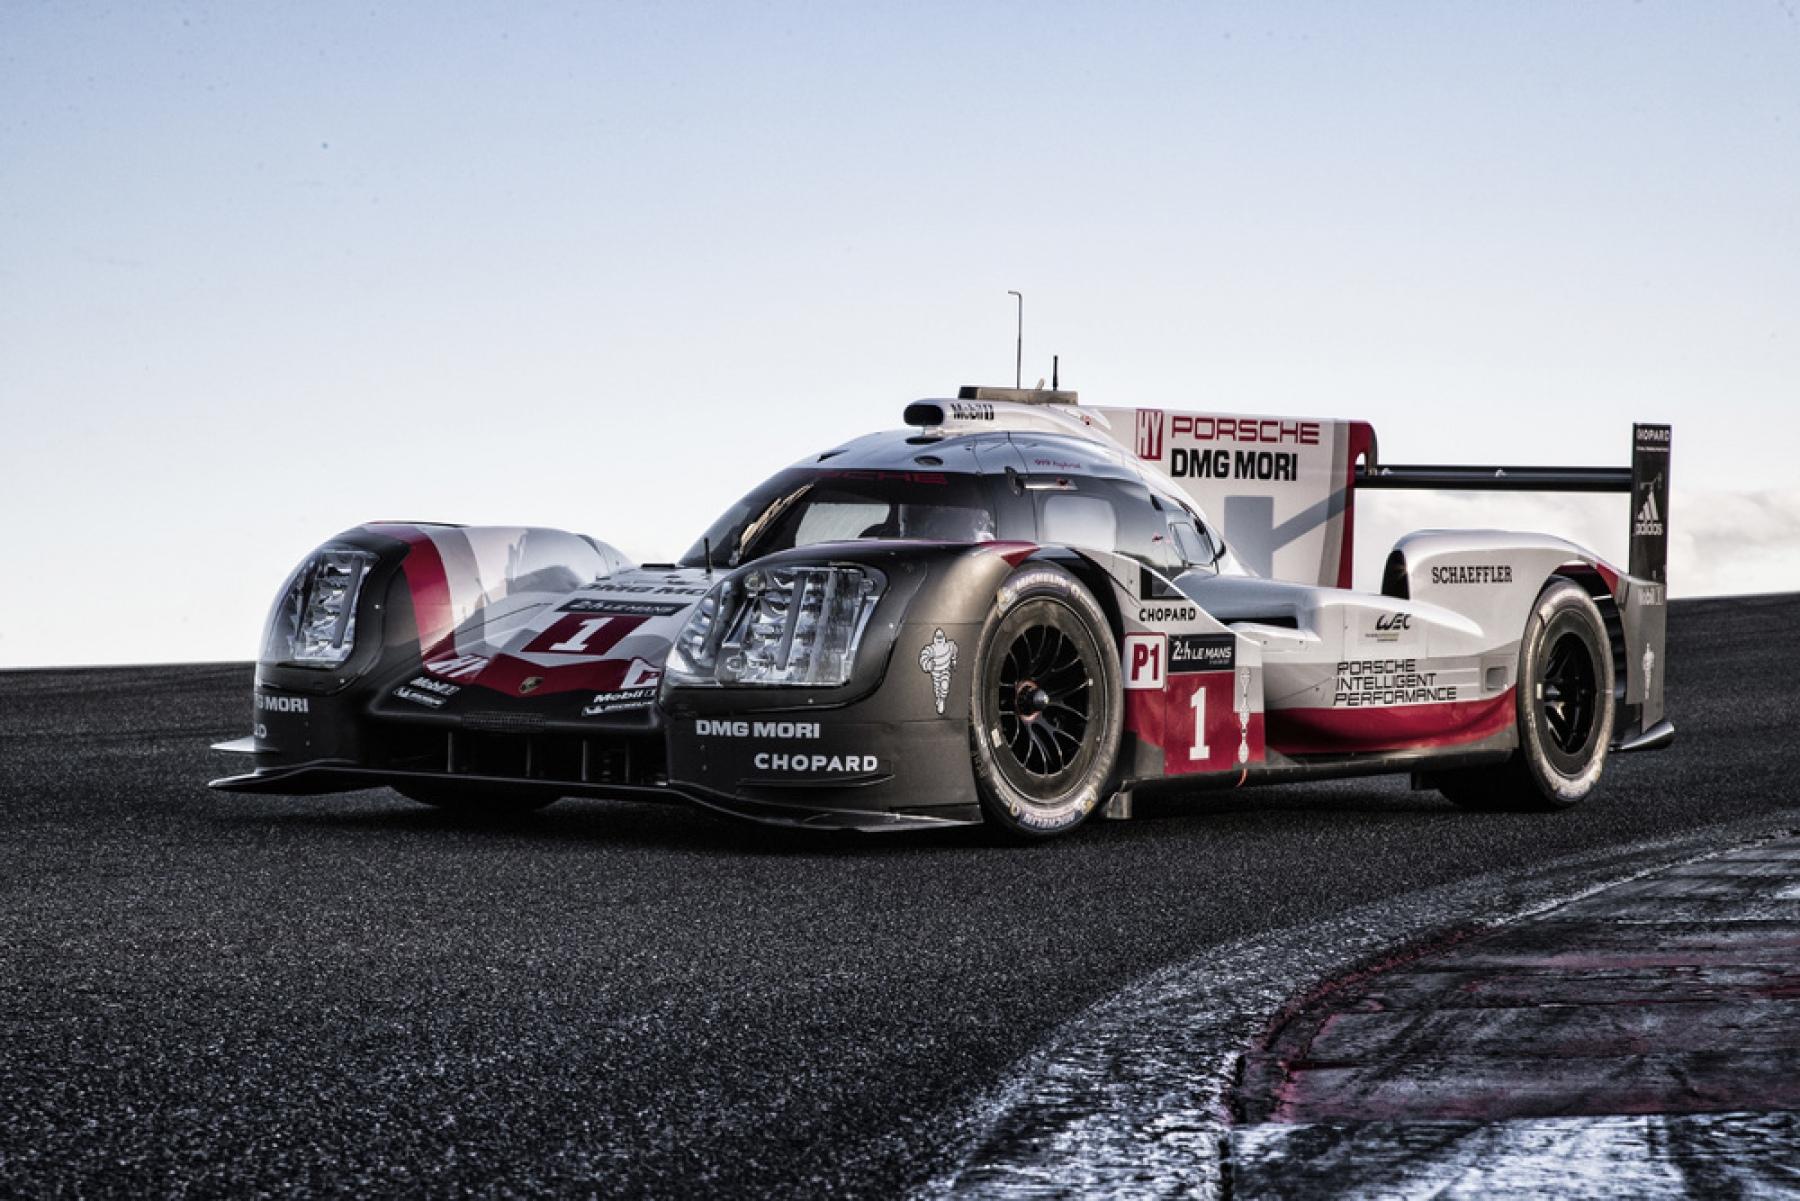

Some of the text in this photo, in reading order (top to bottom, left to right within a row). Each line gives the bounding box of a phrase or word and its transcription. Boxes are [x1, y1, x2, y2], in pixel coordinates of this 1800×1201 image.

[1137, 410, 1162, 457] HY
[1172, 416, 1320, 445] PORSCHE
[1171, 448, 1298, 481] DMG MORI
[1431, 566, 1513, 584] SCHAEFFLER
[1139, 607, 1196, 621] CHOPARD
[1375, 611, 1413, 631] WEC
[549, 617, 615, 651] 1
[1131, 643, 1160, 681] P1
[1192, 647, 1205, 660] LE
[1205, 646, 1232, 659] MANS
[1337, 659, 1416, 675] PORSCHE
[1335, 673, 1437, 691] INTELLIGENT
[264, 696, 309, 713] MORI
[593, 689, 643, 703] Mobil
[1333, 686, 1457, 706] PERFORMANCE
[695, 720, 820, 738] DMG MORI
[1189, 687, 1210, 761] 1
[754, 753, 878, 772] CHOPARD
